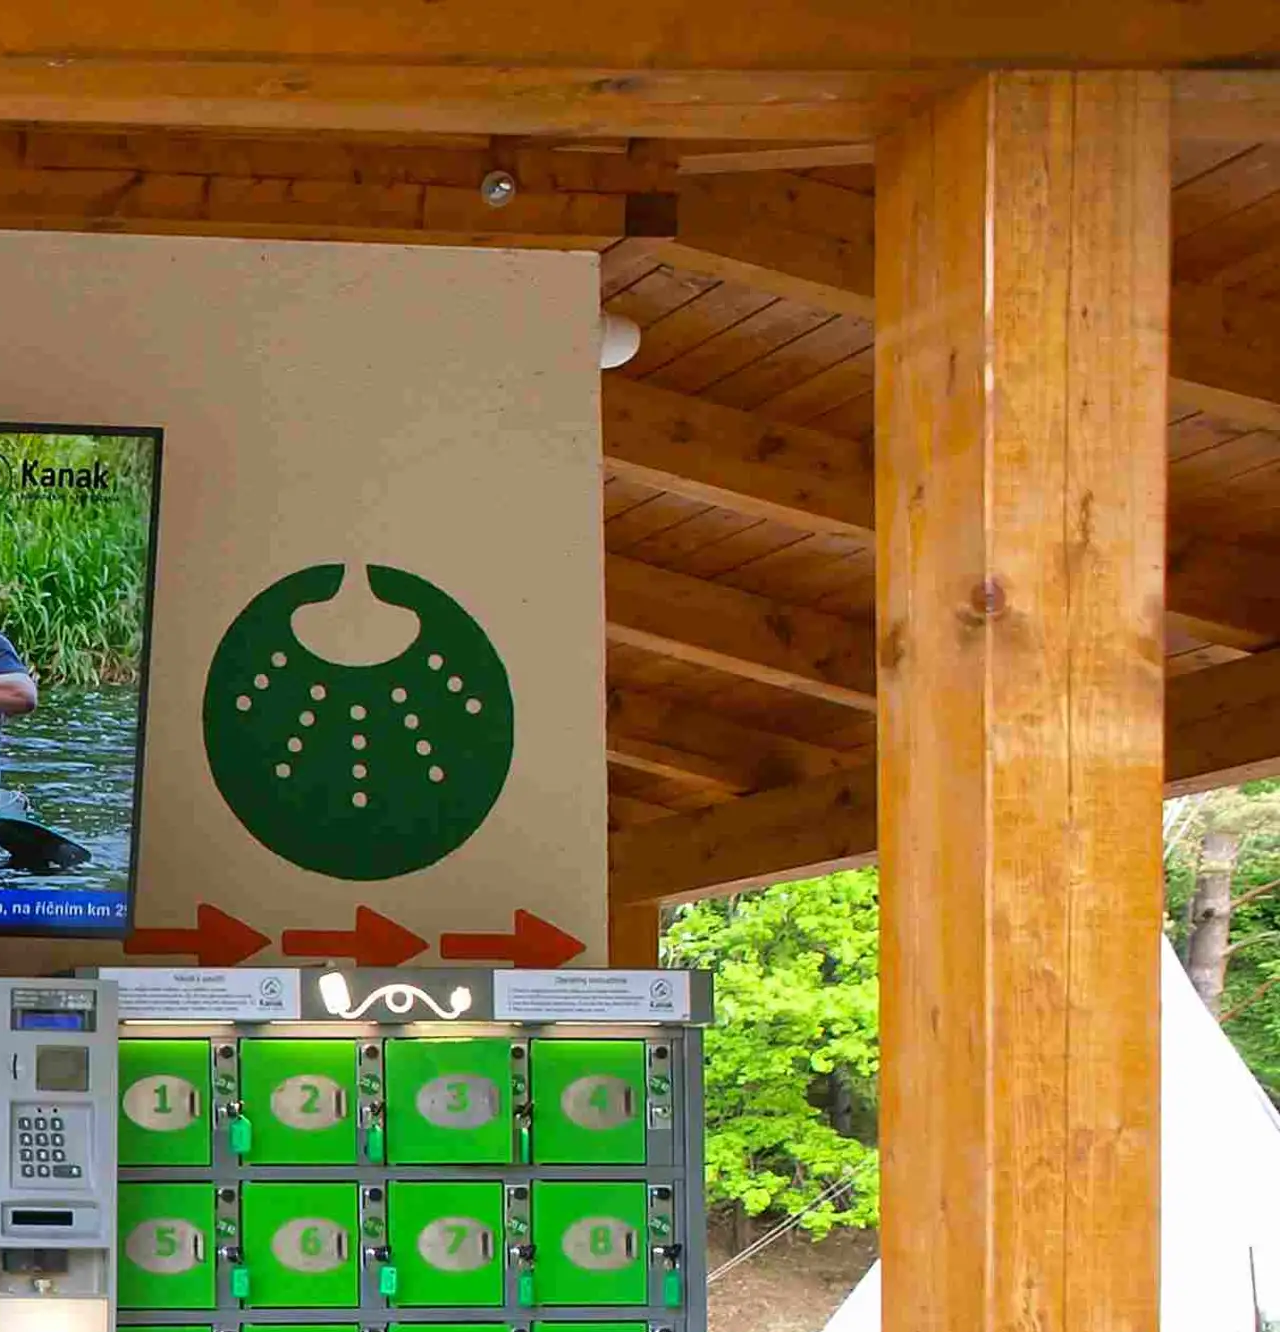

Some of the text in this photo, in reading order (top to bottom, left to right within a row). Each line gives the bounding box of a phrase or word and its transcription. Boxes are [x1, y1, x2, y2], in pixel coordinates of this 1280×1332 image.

[22, 459, 109, 489] Kanak
[12, 904, 32, 916] na
[88, 903, 111, 918] km
[153, 1085, 172, 1113] 1
[301, 1085, 321, 1113] 2
[447, 1083, 470, 1112] 3
[586, 1084, 610, 1112] 4
[154, 1227, 177, 1256] 5
[300, 1226, 322, 1256] 6
[445, 1226, 469, 1255] 7
[589, 1226, 612, 1255] 8
